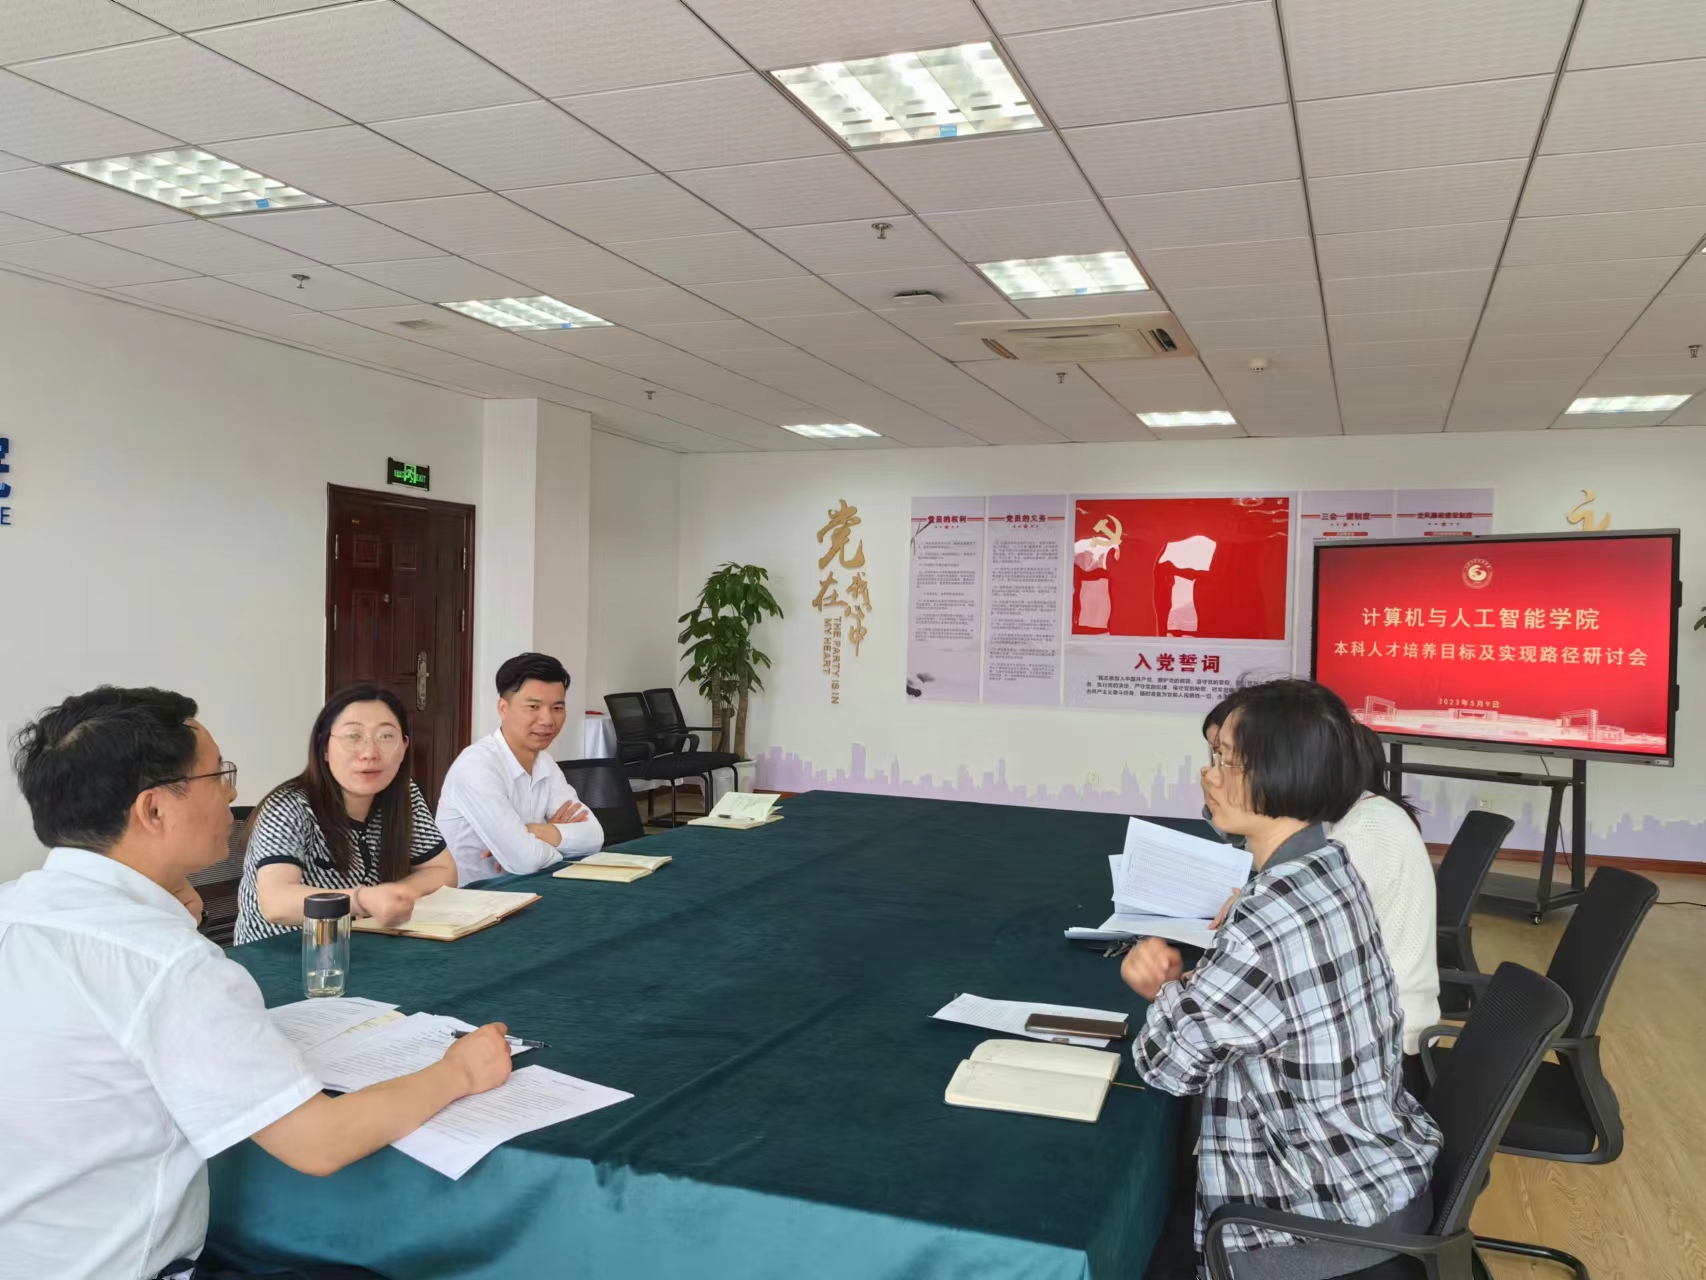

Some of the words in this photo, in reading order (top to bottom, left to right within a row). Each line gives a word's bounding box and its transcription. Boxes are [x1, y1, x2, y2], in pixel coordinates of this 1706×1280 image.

[927, 515, 967, 523] 党员的权利
[1005, 514, 1047, 522] 党员的义务
[824, 618, 832, 634] MY
[833, 615, 841, 638] THE
[1362, 607, 1600, 631] 计算机与人工智能学院
[823, 637, 831, 675] HEART
[832, 641, 840, 677] PARTY
[1134, 652, 1221, 673] 入党誓词
[1334, 641, 1648, 667] 本科人才培养目标及实现路径研讨会
[831, 680, 839, 689] IS
[831, 692, 839, 704] IN
[1439, 698, 1499, 708] 2023年5月9日
